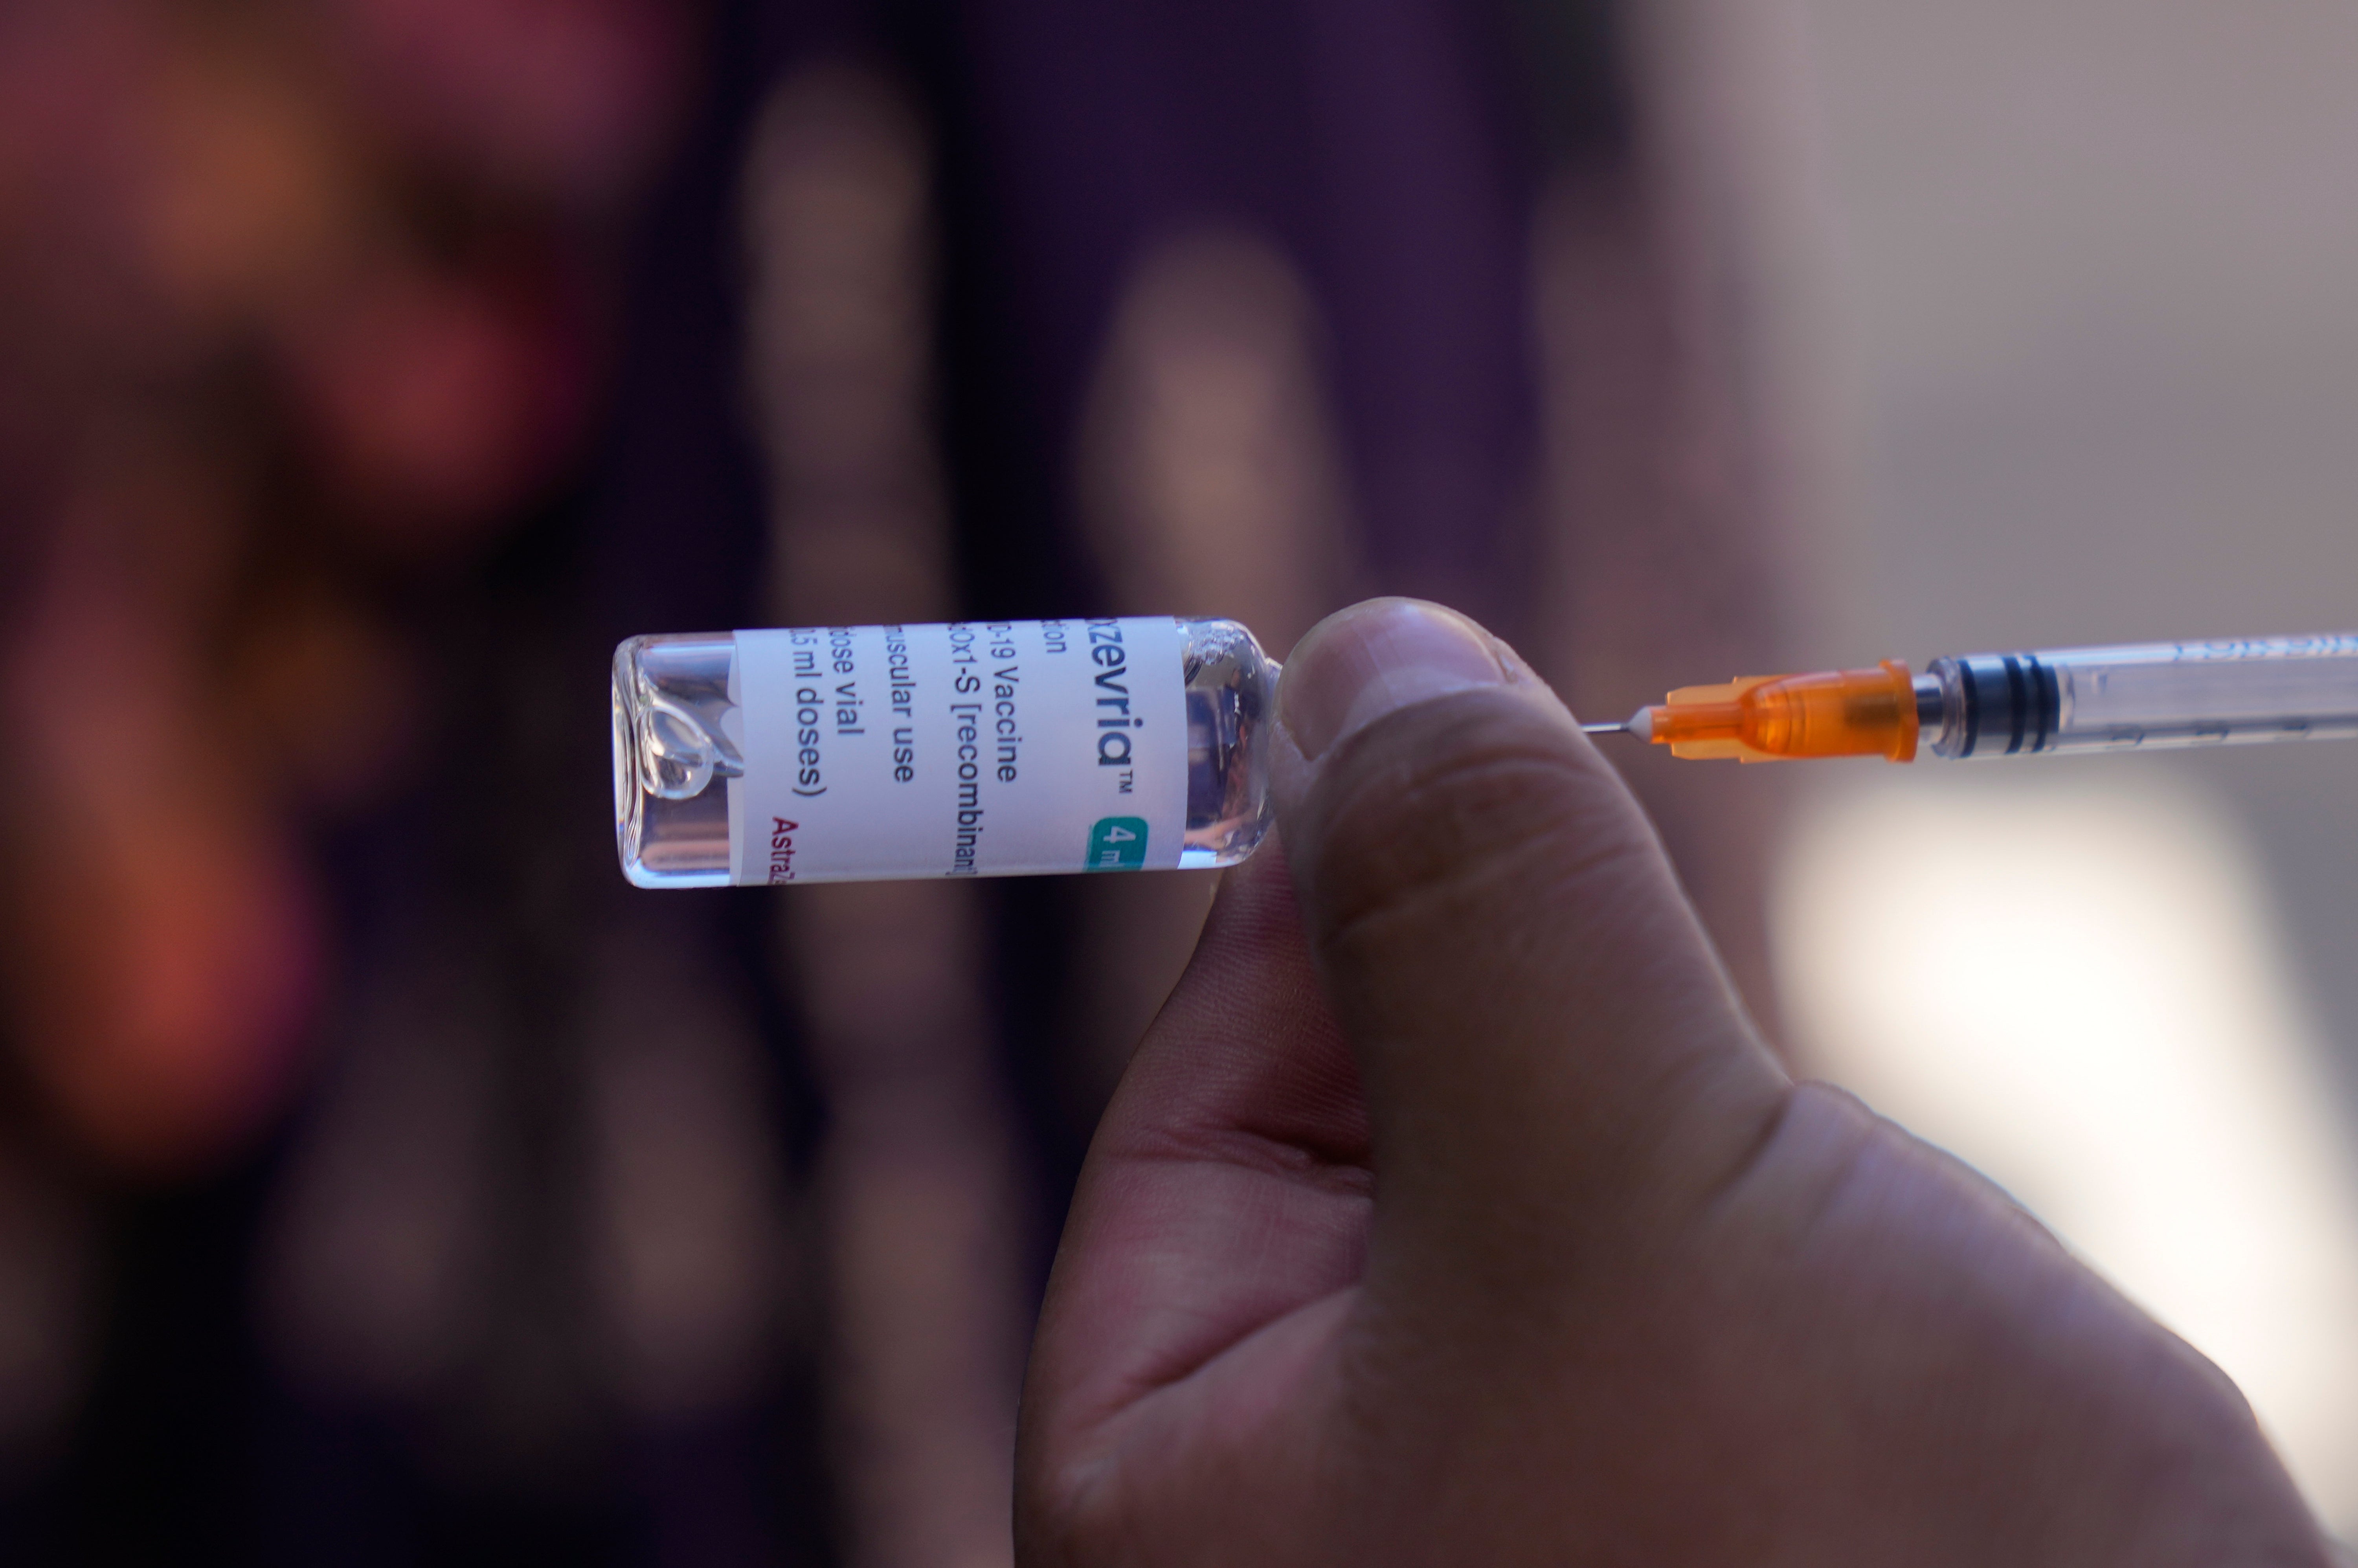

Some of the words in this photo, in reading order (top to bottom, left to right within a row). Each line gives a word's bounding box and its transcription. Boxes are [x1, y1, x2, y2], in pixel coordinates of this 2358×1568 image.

[793, 651, 823, 678] ml
[836, 682, 865, 735] vial
[993, 666, 1022, 783] Vaccine
[792, 687, 827, 798] doses)
[892, 727, 914, 783] use
[1102, 826, 1136, 843] 4
